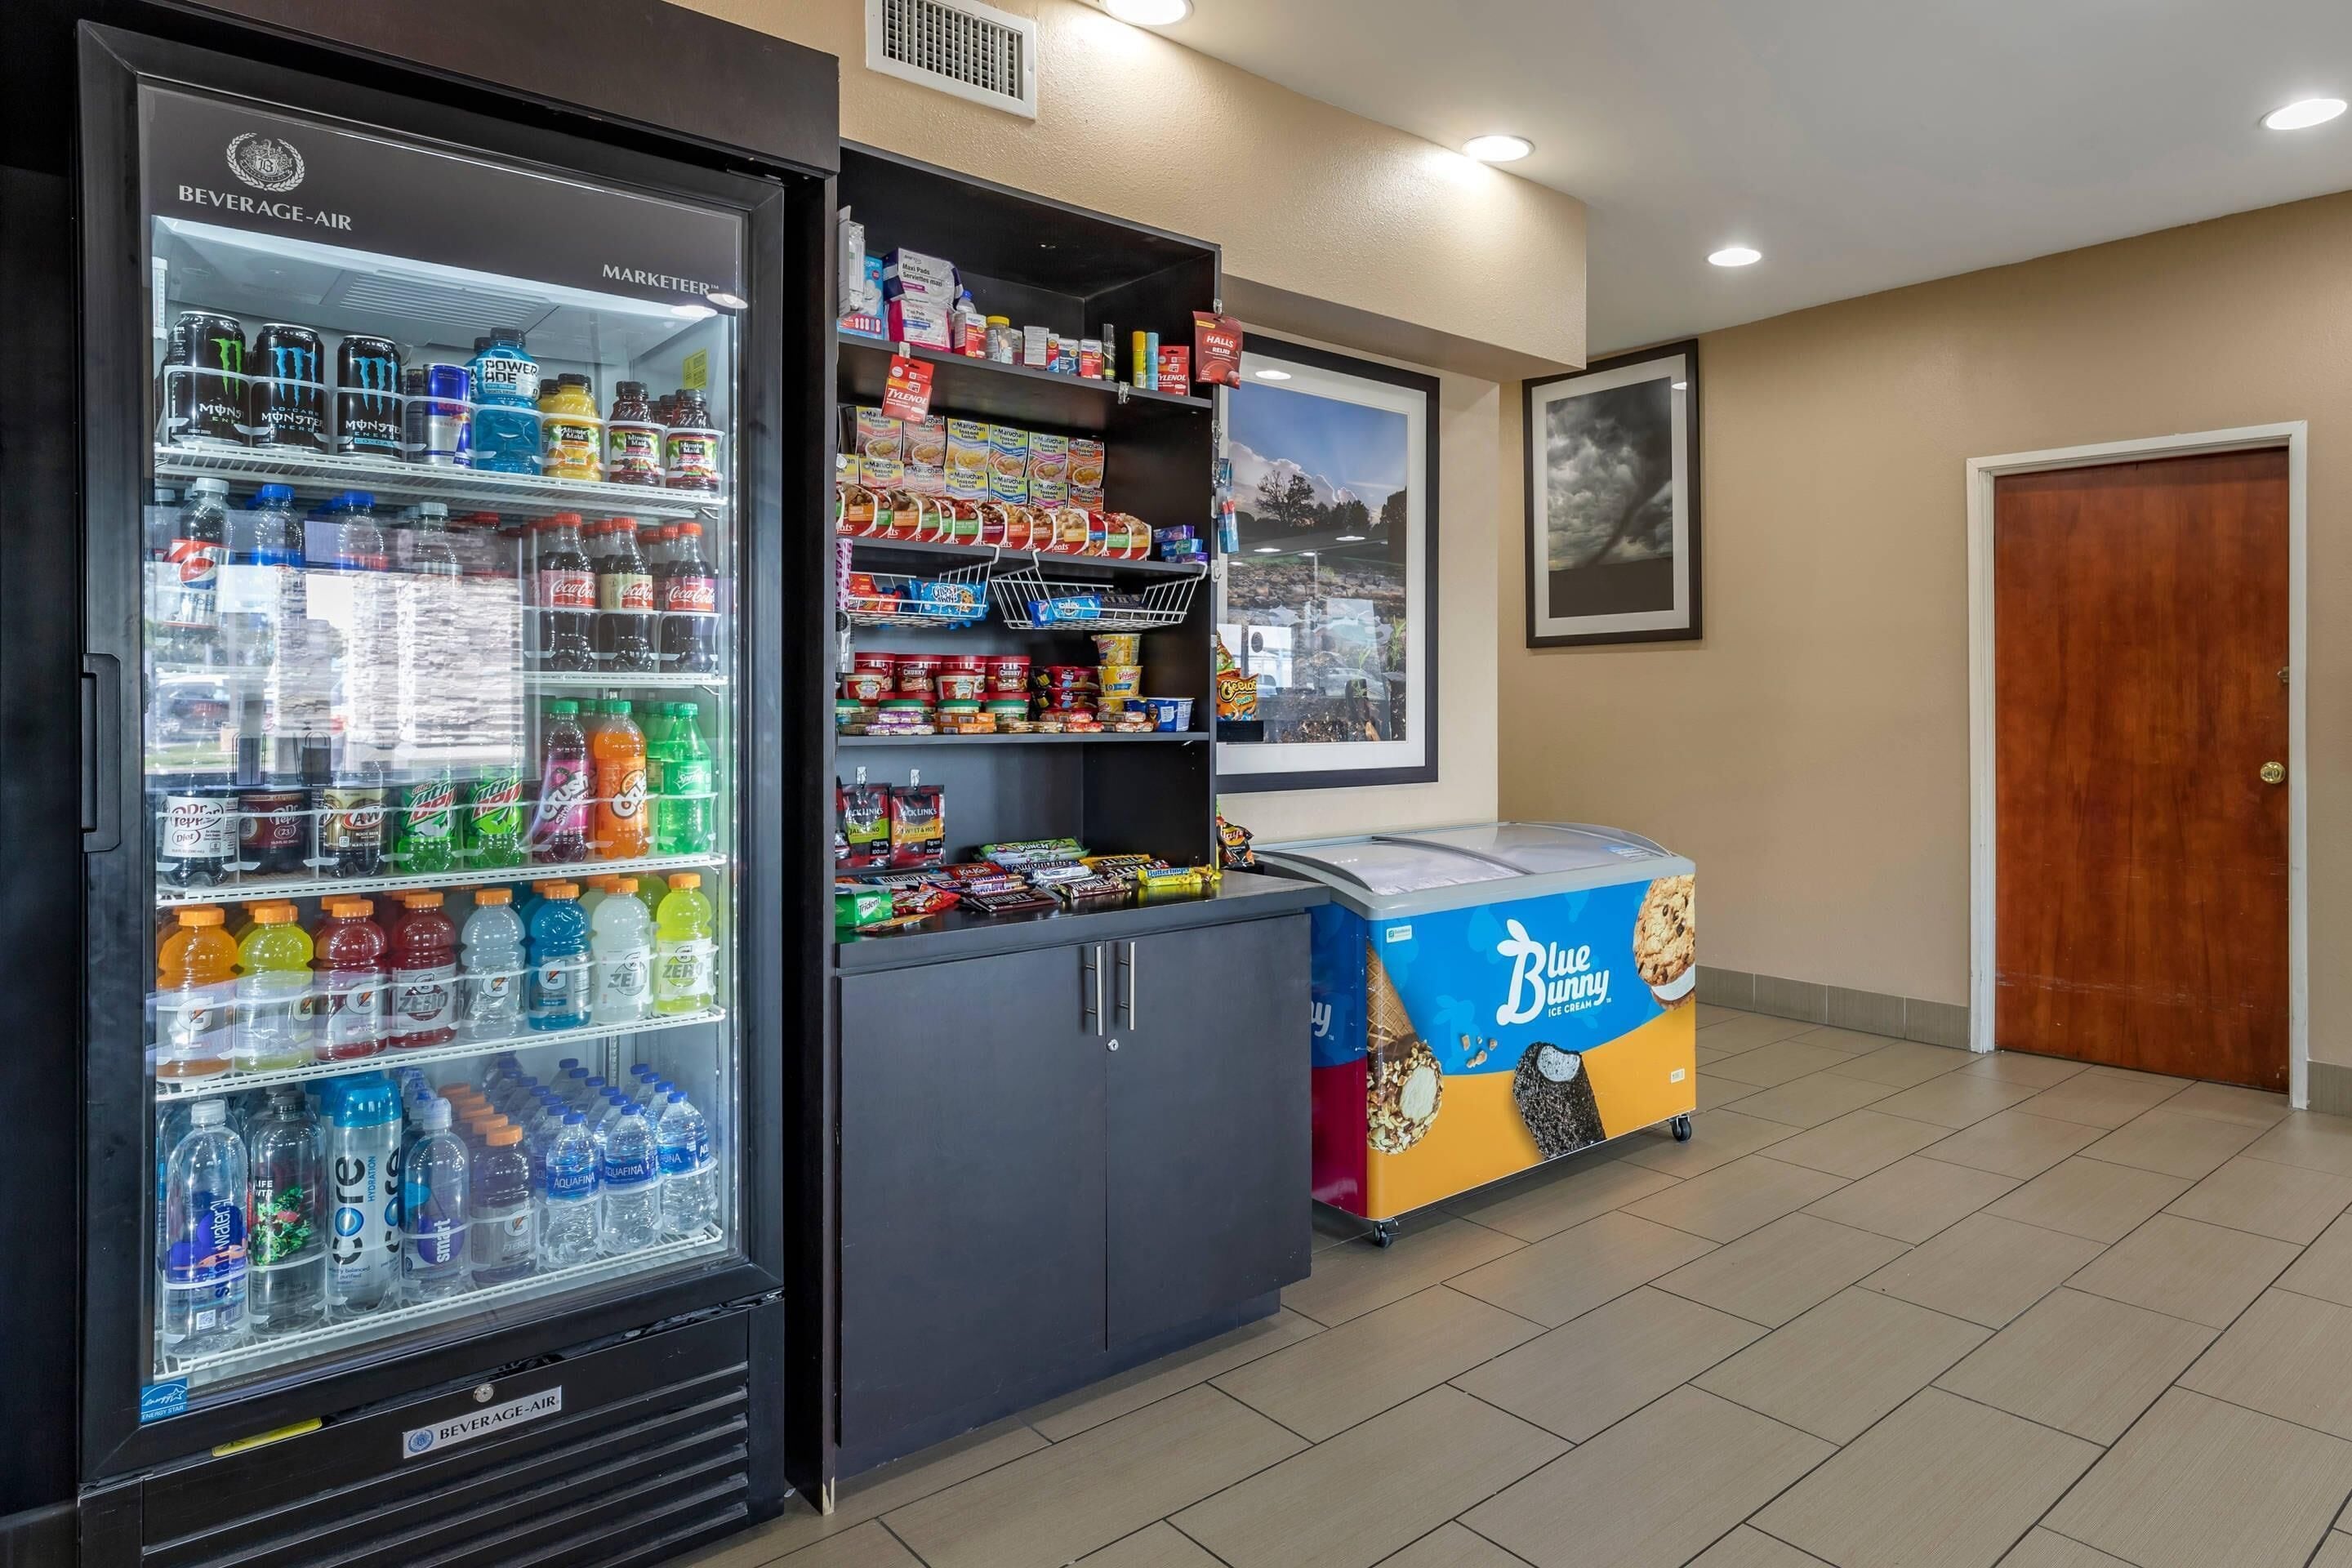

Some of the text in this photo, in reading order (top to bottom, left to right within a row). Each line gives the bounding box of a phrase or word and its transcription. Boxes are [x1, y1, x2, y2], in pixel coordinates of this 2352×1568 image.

[179, 185, 352, 231] BEVERAGE-AIR
[902, 263, 930, 275] Maxi Pads
[902, 272, 929, 283] Serviettes
[1206, 335, 1234, 348] HALLS
[1212, 347, 1230, 355] RELIEF
[485, 359, 537, 376] POWER
[485, 372, 517, 384] ADE
[888, 387, 929, 405] TYLENOL
[956, 422, 986, 432] Maruchan
[998, 429, 1025, 439] Maruchan
[870, 461, 901, 470] Maruchan
[955, 472, 984, 480] Maruchan
[997, 477, 1025, 485] Maruchan
[1038, 483, 1064, 491] Mruchan
[187, 804, 207, 815] Dr
[849, 808, 862, 817] ACK
[176, 833, 194, 843] Diet
[1018, 843, 1049, 852] PUNCH
[858, 896, 881, 913] Trident
[1548, 1000, 1592, 1018] ICE CREAM
[254, 1180, 274, 1188] LIFE
[368, 1156, 376, 1203] HYDRATION
[554, 1171, 595, 1188] AQUAFINA
[332, 1156, 366, 1265] core
[142, 1405, 184, 1420] ENERGY STAR
[439, 1396, 556, 1440] BEVERAGE-AIR
